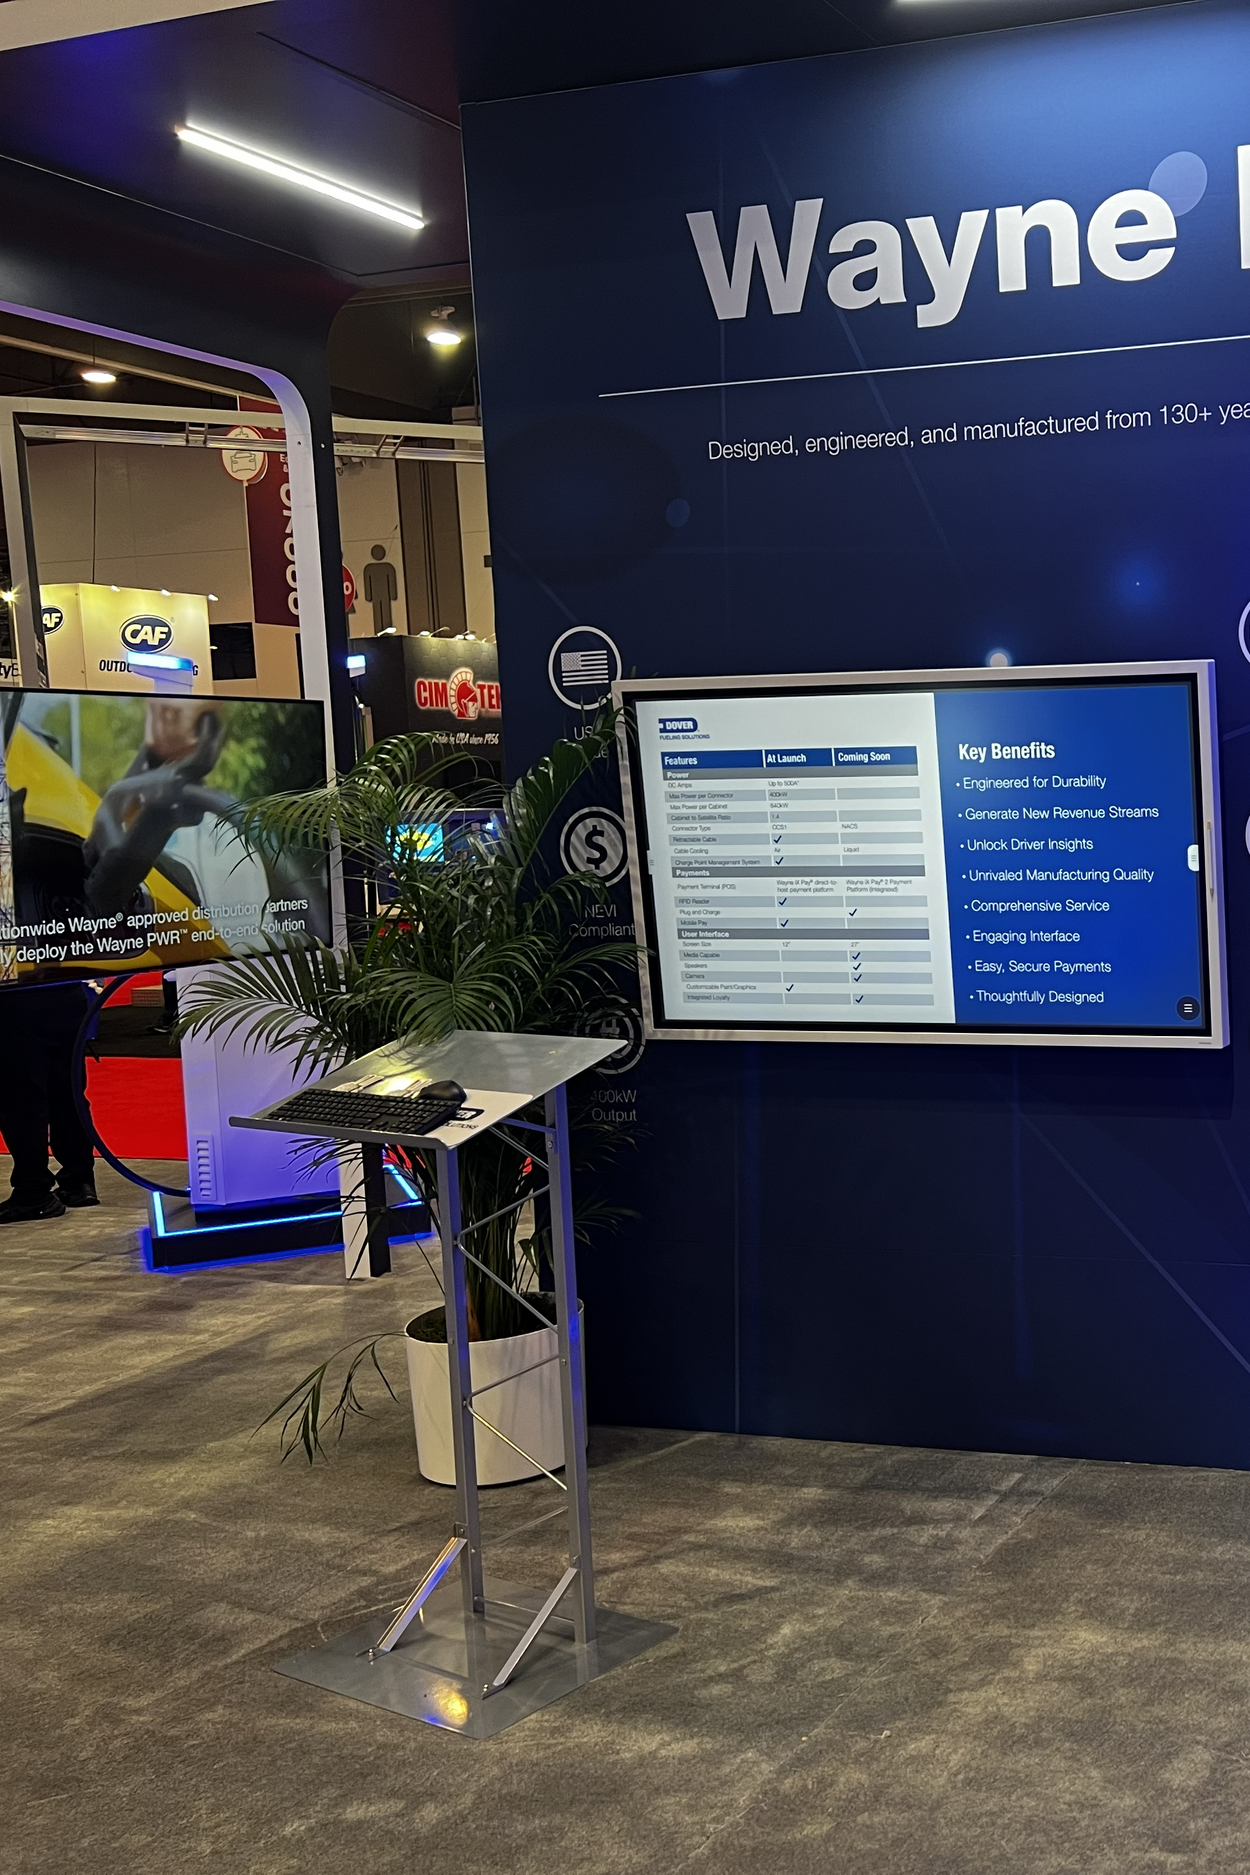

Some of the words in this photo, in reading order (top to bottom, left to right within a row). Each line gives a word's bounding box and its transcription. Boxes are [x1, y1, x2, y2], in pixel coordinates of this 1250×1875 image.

[686, 189, 1177, 328] Wayne
[708, 436, 799, 461] Designed,
[805, 427, 914, 455] engineered,
[921, 423, 957, 444] and
[964, 410, 1099, 439] manufactured
[1106, 410, 1150, 429] from
[1160, 403, 1212, 424] 130+
[42, 614, 61, 627] AF
[124, 625, 169, 645] CAF
[416, 680, 449, 708] CIM
[666, 721, 693, 730] DOVER
[664, 756, 697, 765] Features
[767, 754, 776, 762] At
[778, 754, 806, 762] Launch
[838, 753, 868, 763] Coming
[870, 753, 890, 761] Soon
[959, 744, 986, 763] Key
[991, 742, 1055, 759] Benefits
[964, 777, 1028, 791] Engineered
[1033, 777, 1048, 788] for
[1052, 776, 1106, 789] Durability
[965, 808, 1019, 820] Generate
[1023, 807, 1049, 819] New
[1054, 807, 1105, 818] Revenue
[1109, 806, 1159, 818] Streams
[967, 839, 1007, 850] Unlock
[1011, 839, 1044, 850] Driver
[1048, 838, 1093, 852] Insights
[969, 869, 1022, 881] Unrivaled
[1026, 869, 1110, 882] Manufacturing
[1113, 869, 1154, 882] Quality
[584, 904, 616, 917] NEVI
[971, 900, 1062, 914] Comprehensive
[1065, 900, 1109, 912] Service
[0, 923, 65, 940] tionwide
[127, 909, 188, 928] approved
[192, 904, 259, 920] distribution
[569, 923, 635, 938] Compliant
[973, 930, 1026, 944] Engaging
[1030, 930, 1080, 942] Interface
[17, 943, 66, 964] deploy
[71, 941, 93, 955] the
[97, 937, 144, 955] Wayne
[191, 925, 258, 944] end-to-end
[260, 919, 305, 934] solution
[975, 961, 1005, 973] Easy,
[1009, 961, 1050, 972] Secure
[1054, 961, 1111, 974] Payments
[976, 991, 1045, 1004] Thoughtfully
[1049, 991, 1103, 1004] Designed
[592, 1108, 637, 1122] Output
